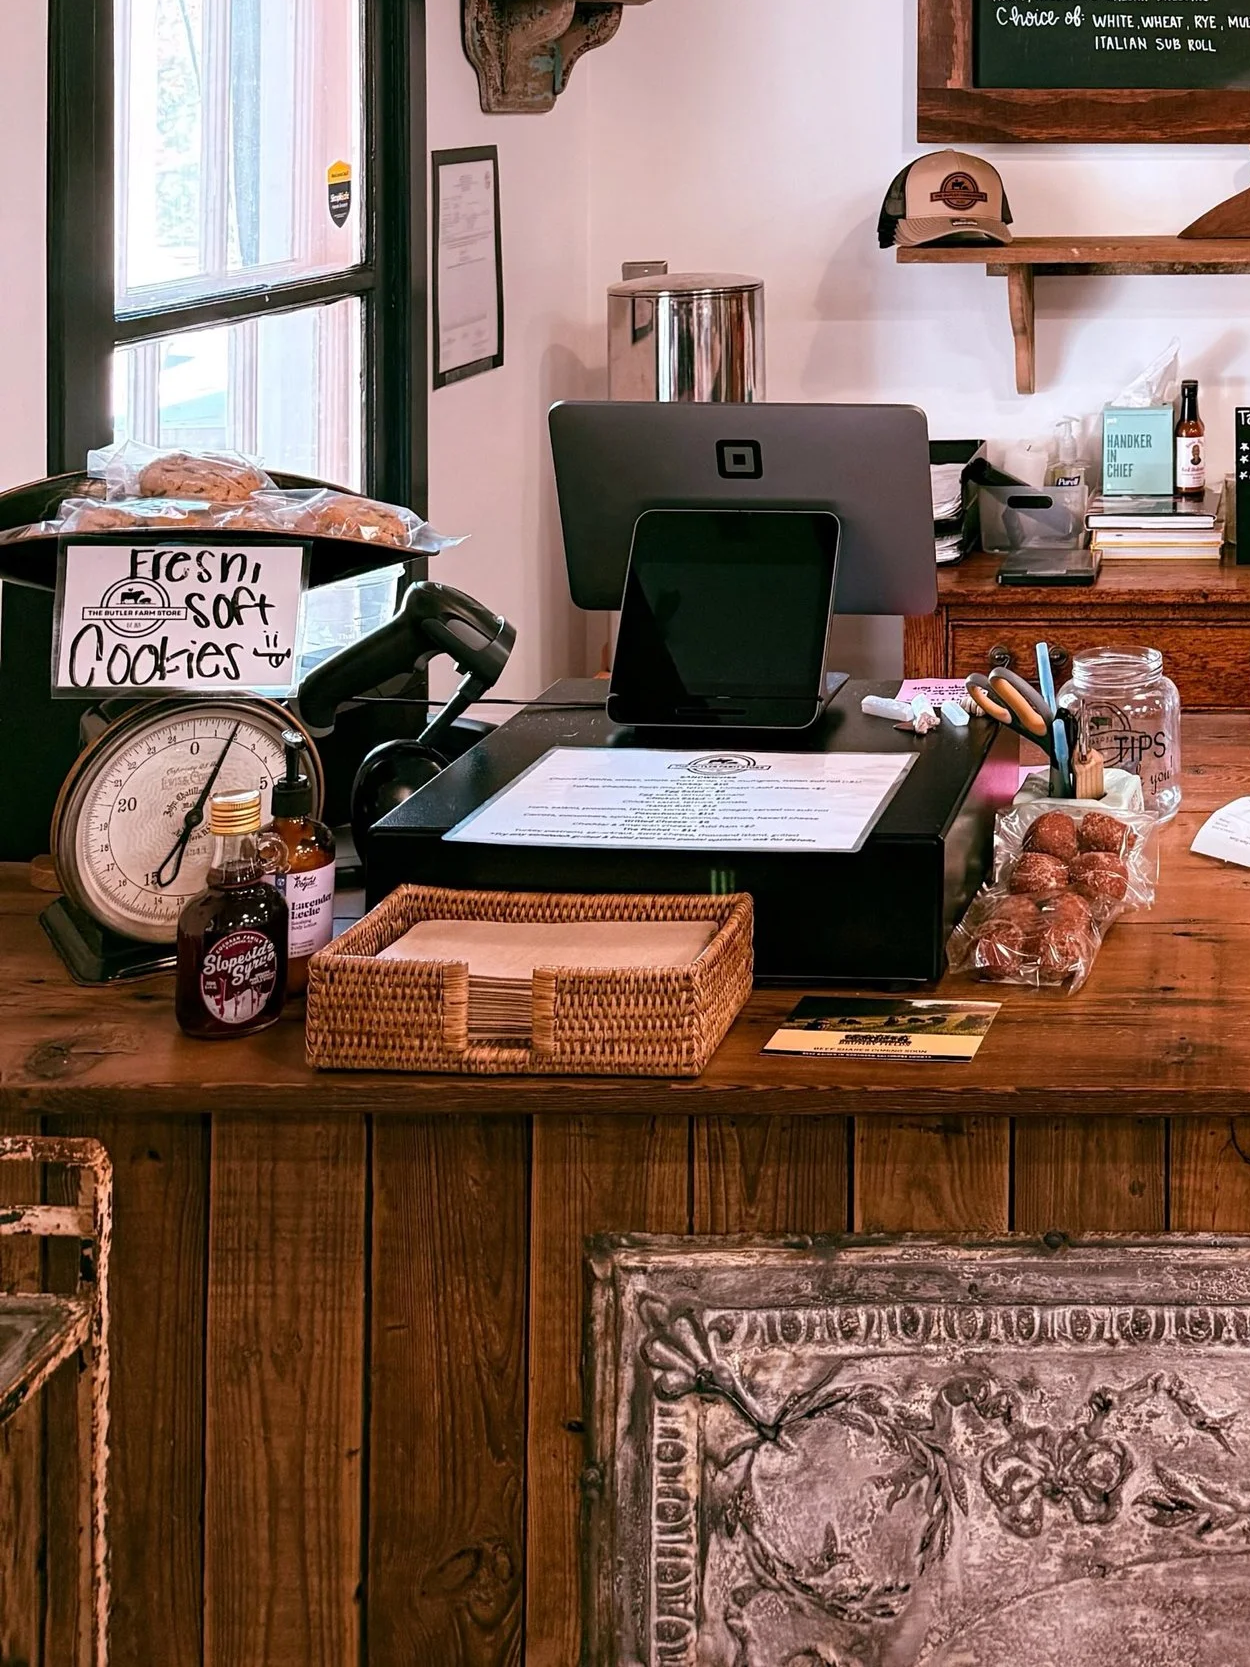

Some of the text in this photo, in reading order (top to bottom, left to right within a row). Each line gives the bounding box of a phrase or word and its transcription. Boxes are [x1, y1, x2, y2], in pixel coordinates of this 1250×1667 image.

[1096, 36, 1216, 51] ITALIAN SUB ROLL
[1107, 434, 1152, 448] HANDKER
[1107, 449, 1117, 463] IN
[1107, 464, 1133, 478] CHIEF
[185, 586, 275, 629] soft
[69, 624, 244, 687] Cookies
[168, 736, 177, 744] 24
[1114, 732, 1166, 762] TIPS
[190, 743, 199, 755] 0
[259, 777, 267, 789] 5
[117, 798, 137, 812] 20
[203, 940, 274, 975] Slopeside
